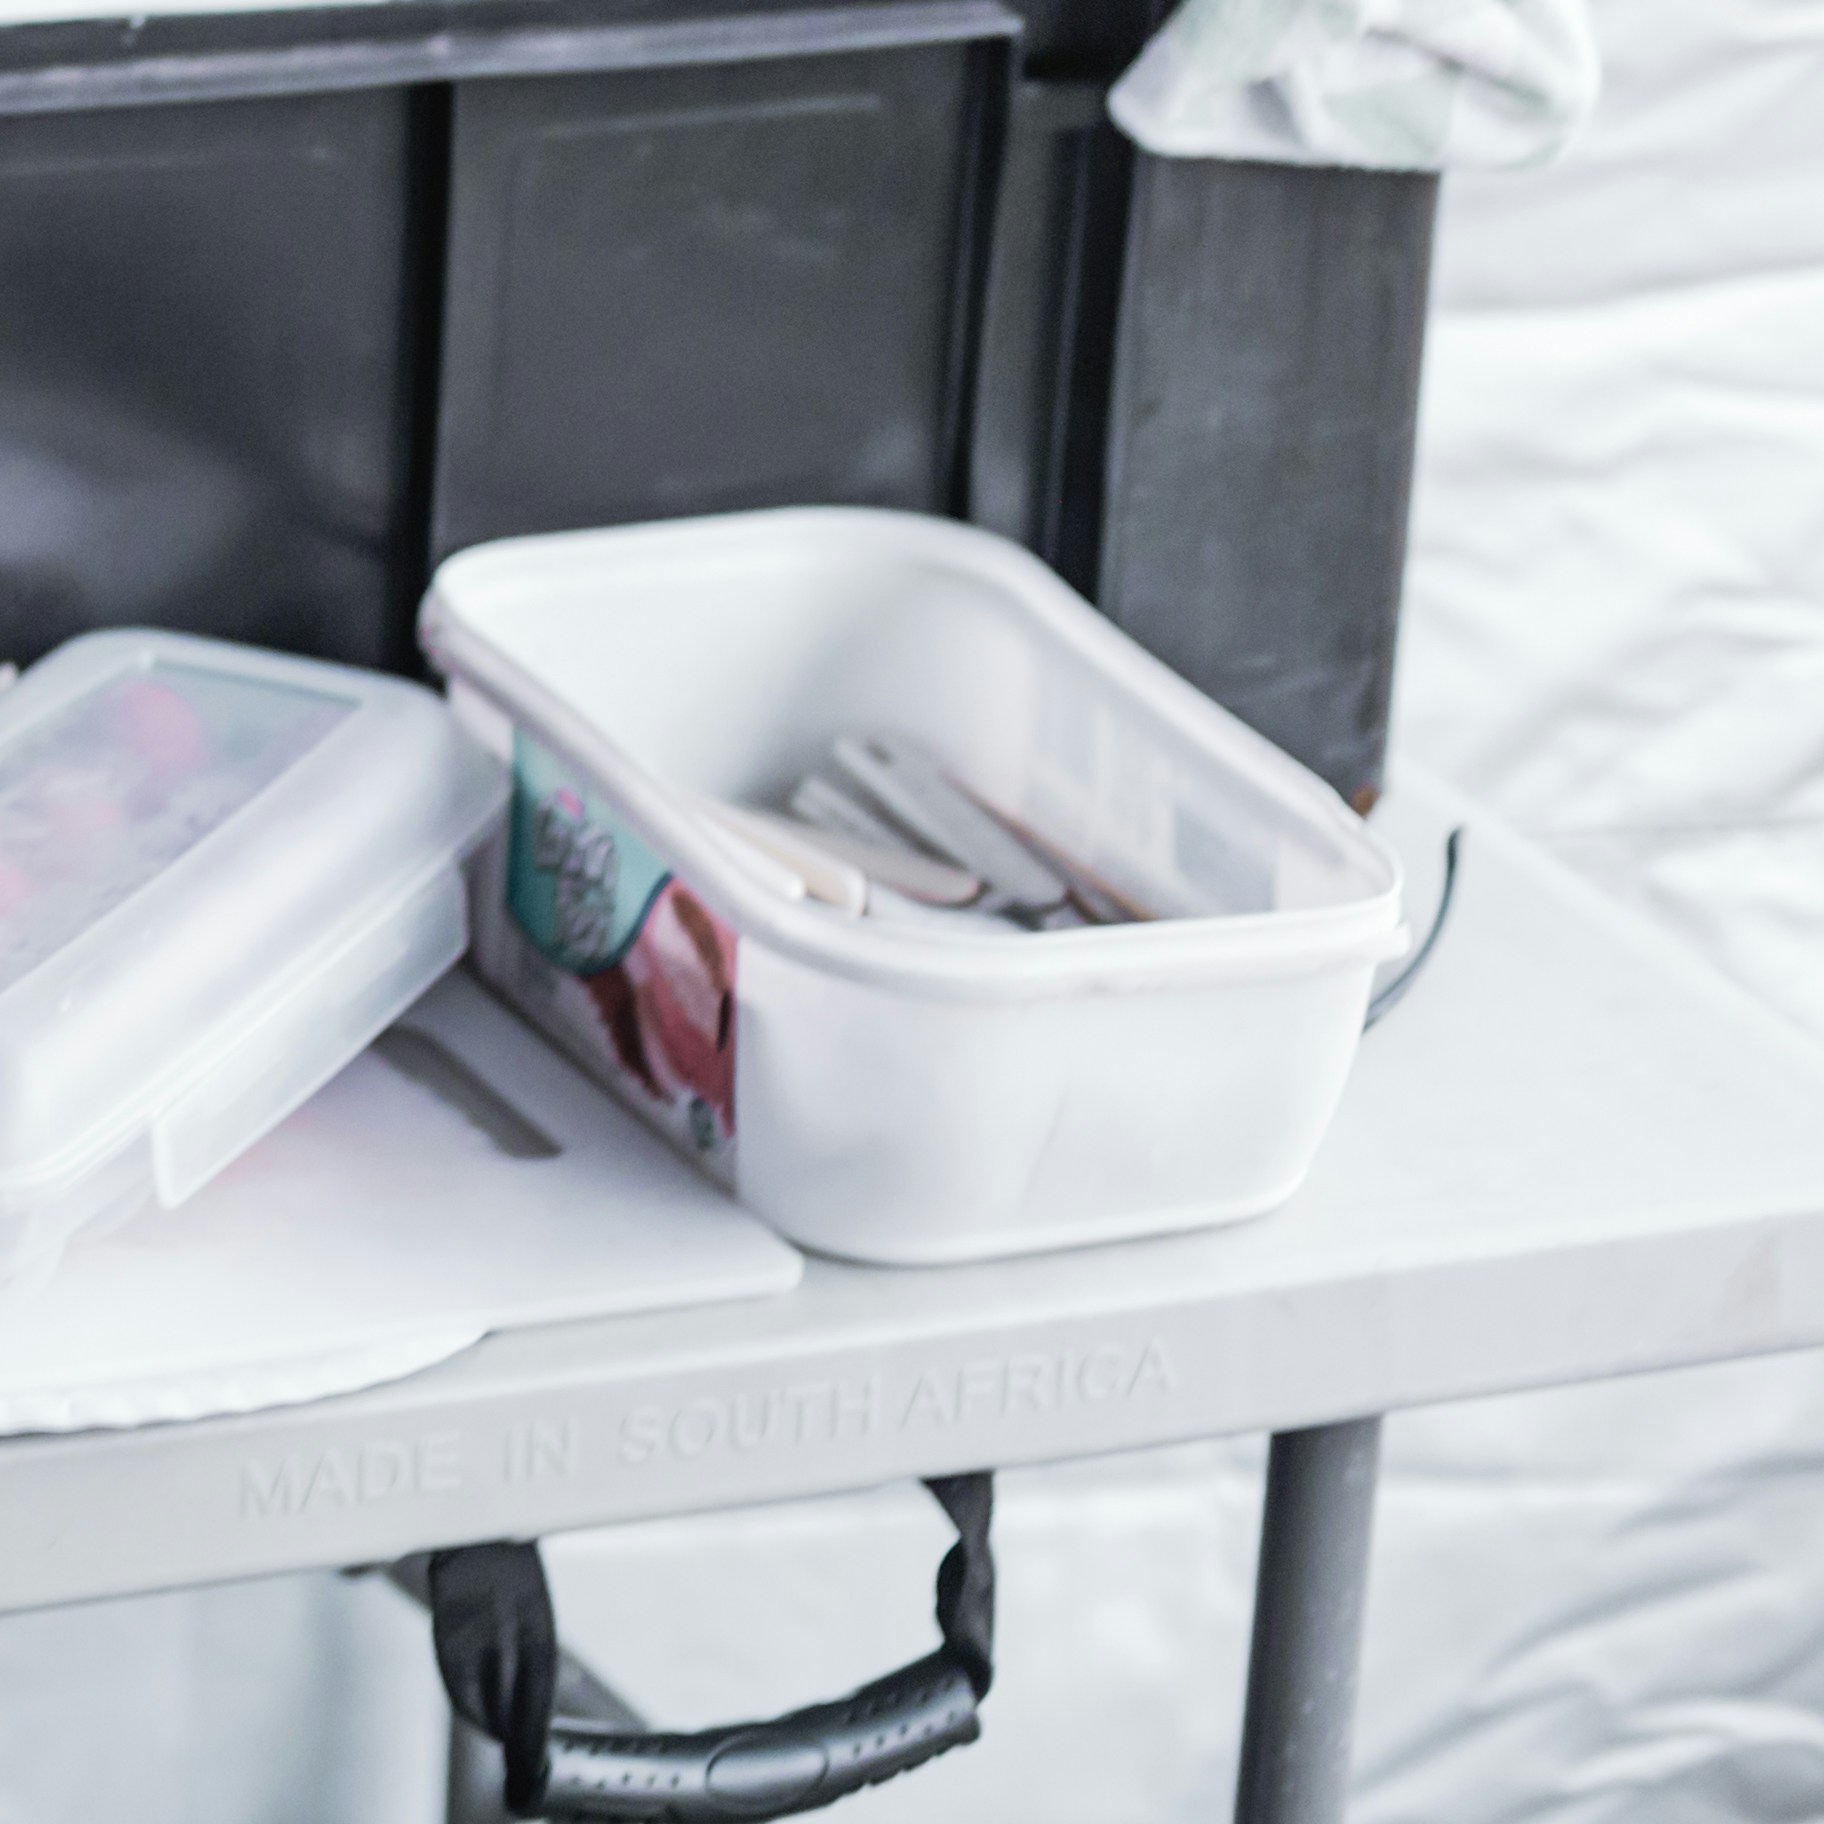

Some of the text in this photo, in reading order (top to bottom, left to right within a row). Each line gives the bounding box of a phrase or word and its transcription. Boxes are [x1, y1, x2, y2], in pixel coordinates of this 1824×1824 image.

[236, 1336, 1180, 1519] MADE IN SOUTH AFRICA
